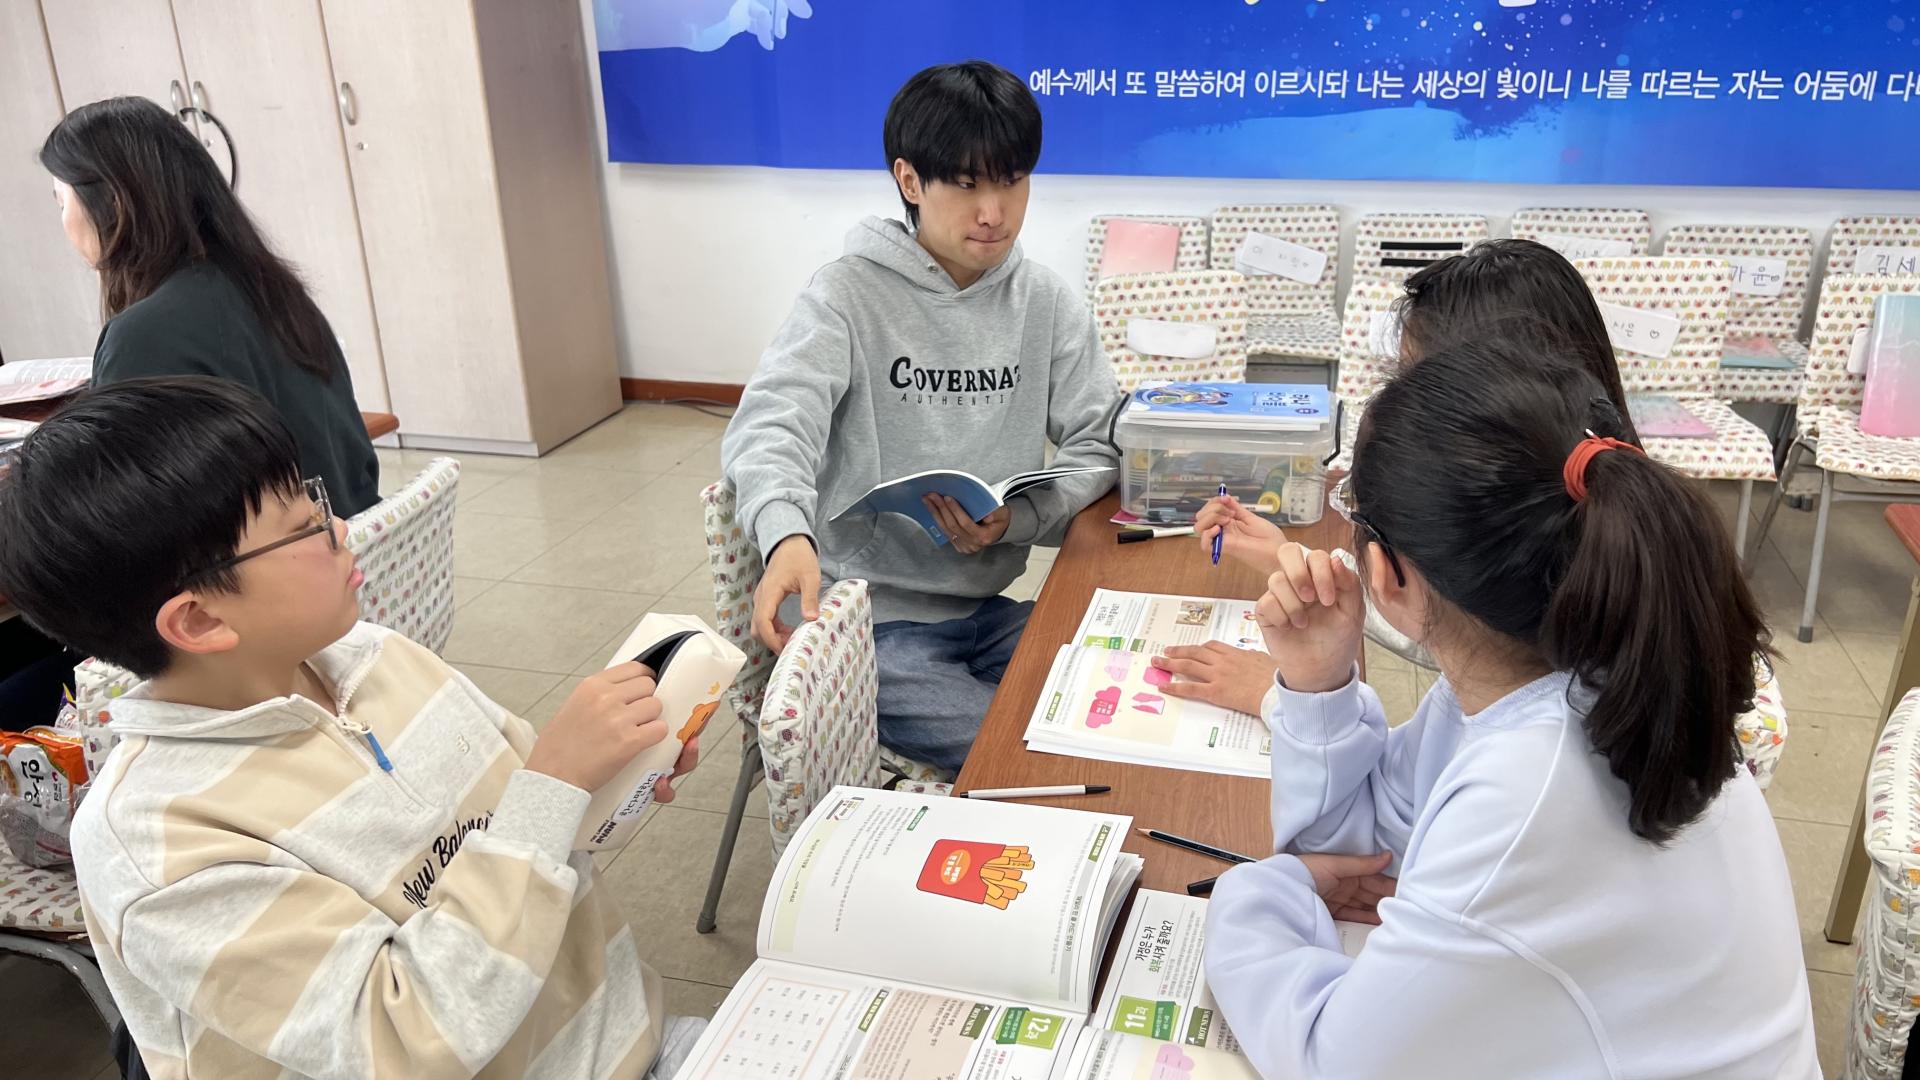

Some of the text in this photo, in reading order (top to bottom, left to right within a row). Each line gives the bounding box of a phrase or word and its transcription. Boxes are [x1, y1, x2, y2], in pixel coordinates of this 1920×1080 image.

[1029, 68, 1117, 97] 예수께서
[1123, 71, 1147, 95] 또
[1155, 69, 1246, 98] 말씀하여
[1254, 69, 1348, 99] 이르시되
[1356, 70, 1404, 99] 나는
[1411, 70, 1487, 99] 세상의
[1496, 67, 1572, 99] 빛이니
[1581, 69, 1632, 99] 나를
[1641, 69, 1721, 99] 따르는
[1728, 69, 1784, 100] 자는
[1793, 70, 1878, 101] 어둠에
[403, 859, 436, 909] New
[1135, 925, 1156, 963] 가정은 누가
